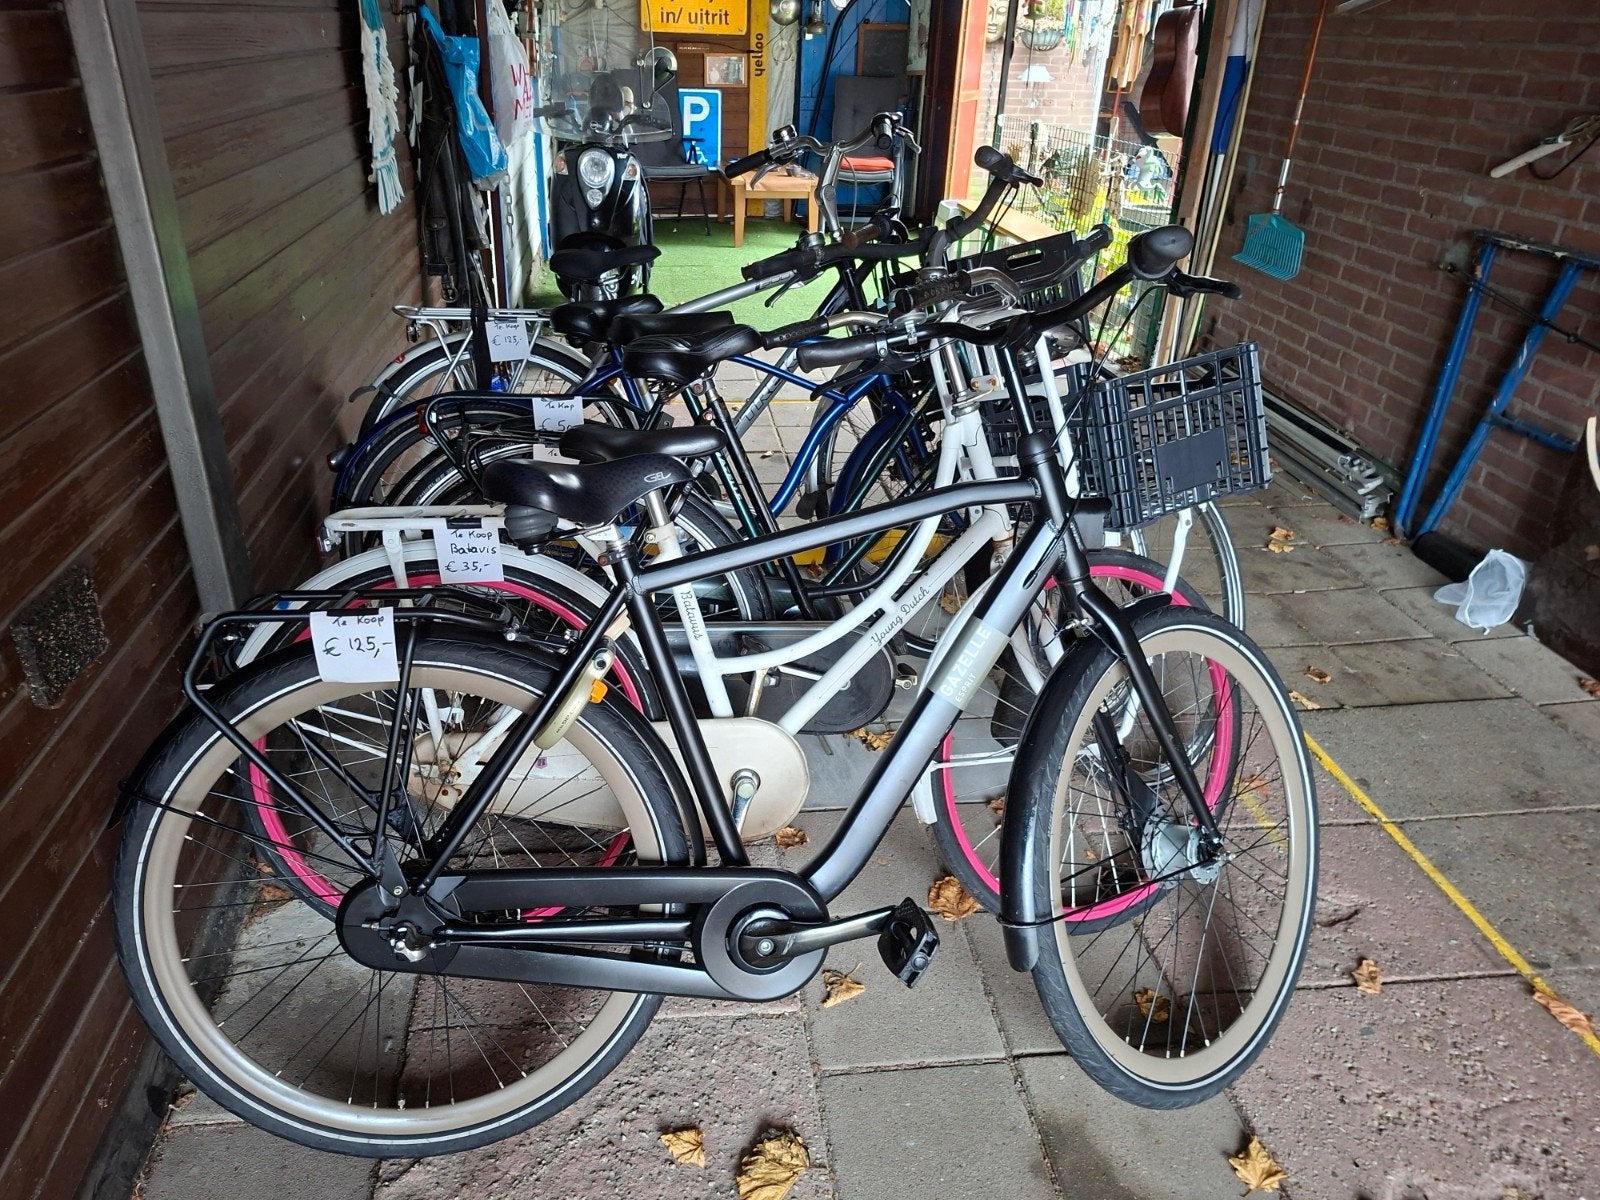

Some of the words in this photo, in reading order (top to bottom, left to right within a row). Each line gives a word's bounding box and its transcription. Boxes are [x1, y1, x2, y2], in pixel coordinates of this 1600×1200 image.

[660, 7, 683, 24] in/
[688, 8, 730, 26] uitrit
[751, 33, 766, 77] yelloo
[683, 95, 710, 136] P
[491, 334, 501, 346] €
[545, 401, 555, 409] Te
[547, 449, 558, 457] Te
[643, 471, 672, 483] GEL
[450, 528, 463, 539] Te
[468, 530, 493, 540] Koop
[450, 543, 497, 555] Batavis
[444, 560, 458, 573] €
[461, 561, 491, 573] 35,-
[332, 616, 347, 627] Te
[357, 615, 384, 627] Koop
[680, 590, 703, 641] Batavus
[870, 615, 903, 647] Young
[900, 586, 930, 615] Dutch
[323, 637, 342, 657] €
[348, 636, 393, 659] 125,-
[940, 625, 992, 697] GAZELLE
[954, 672, 977, 703] ESPRIT
